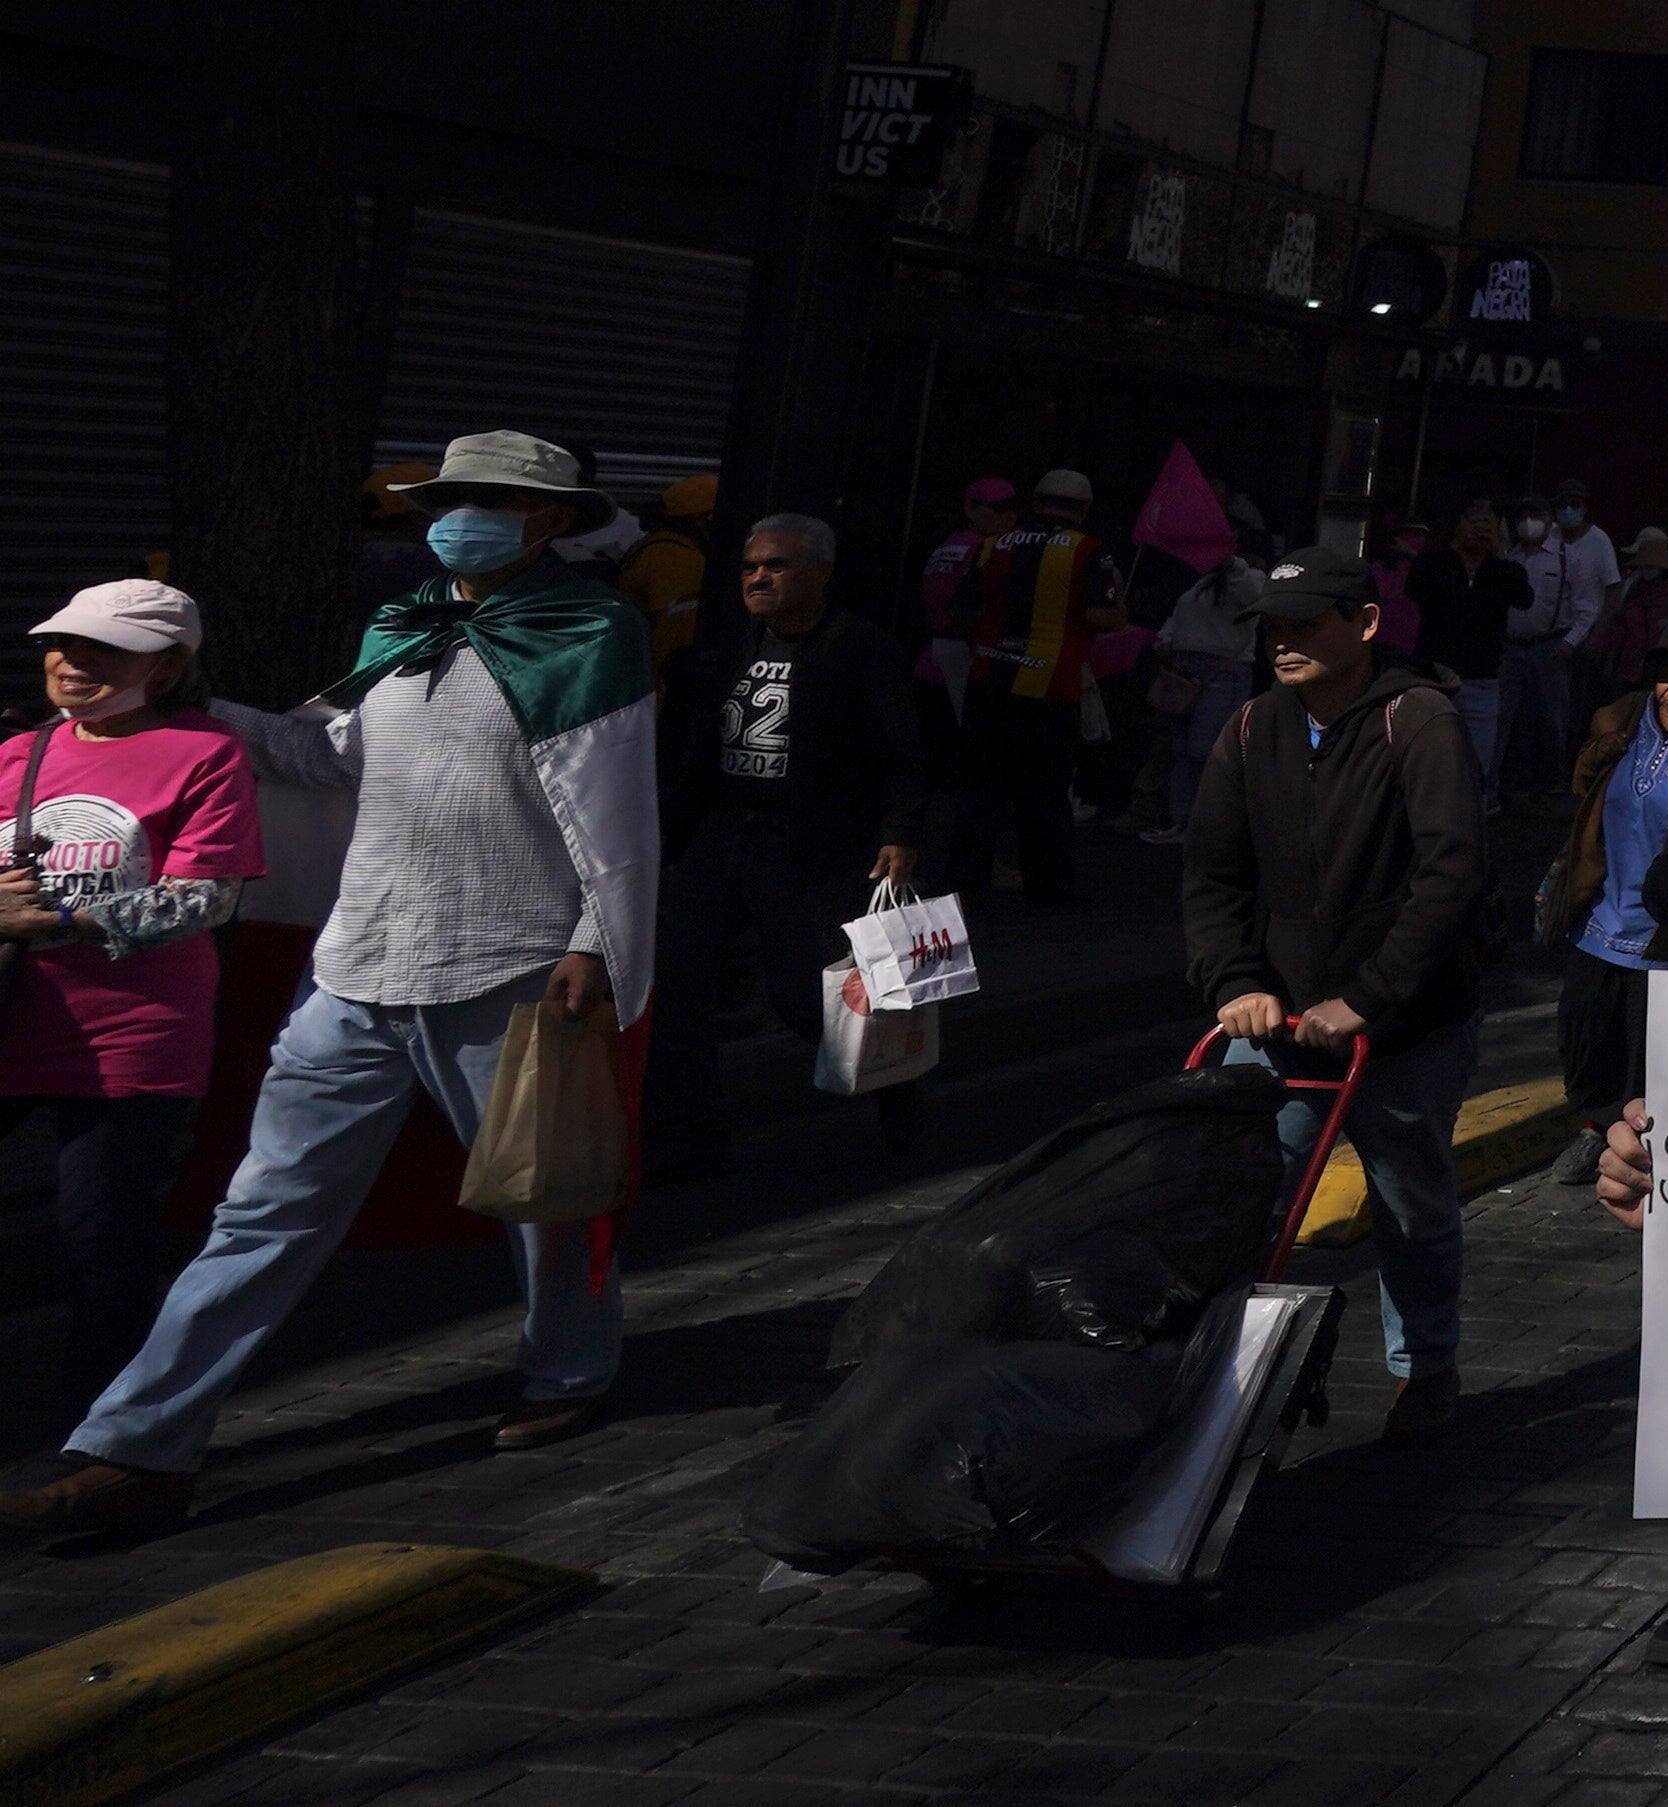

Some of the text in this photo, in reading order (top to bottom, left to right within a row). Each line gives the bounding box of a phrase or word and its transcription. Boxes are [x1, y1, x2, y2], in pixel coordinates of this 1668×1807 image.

[846, 75, 917, 110] INN
[840, 110, 934, 144] VICT
[836, 144, 890, 177] US
[909, 928, 953, 970] H&M
